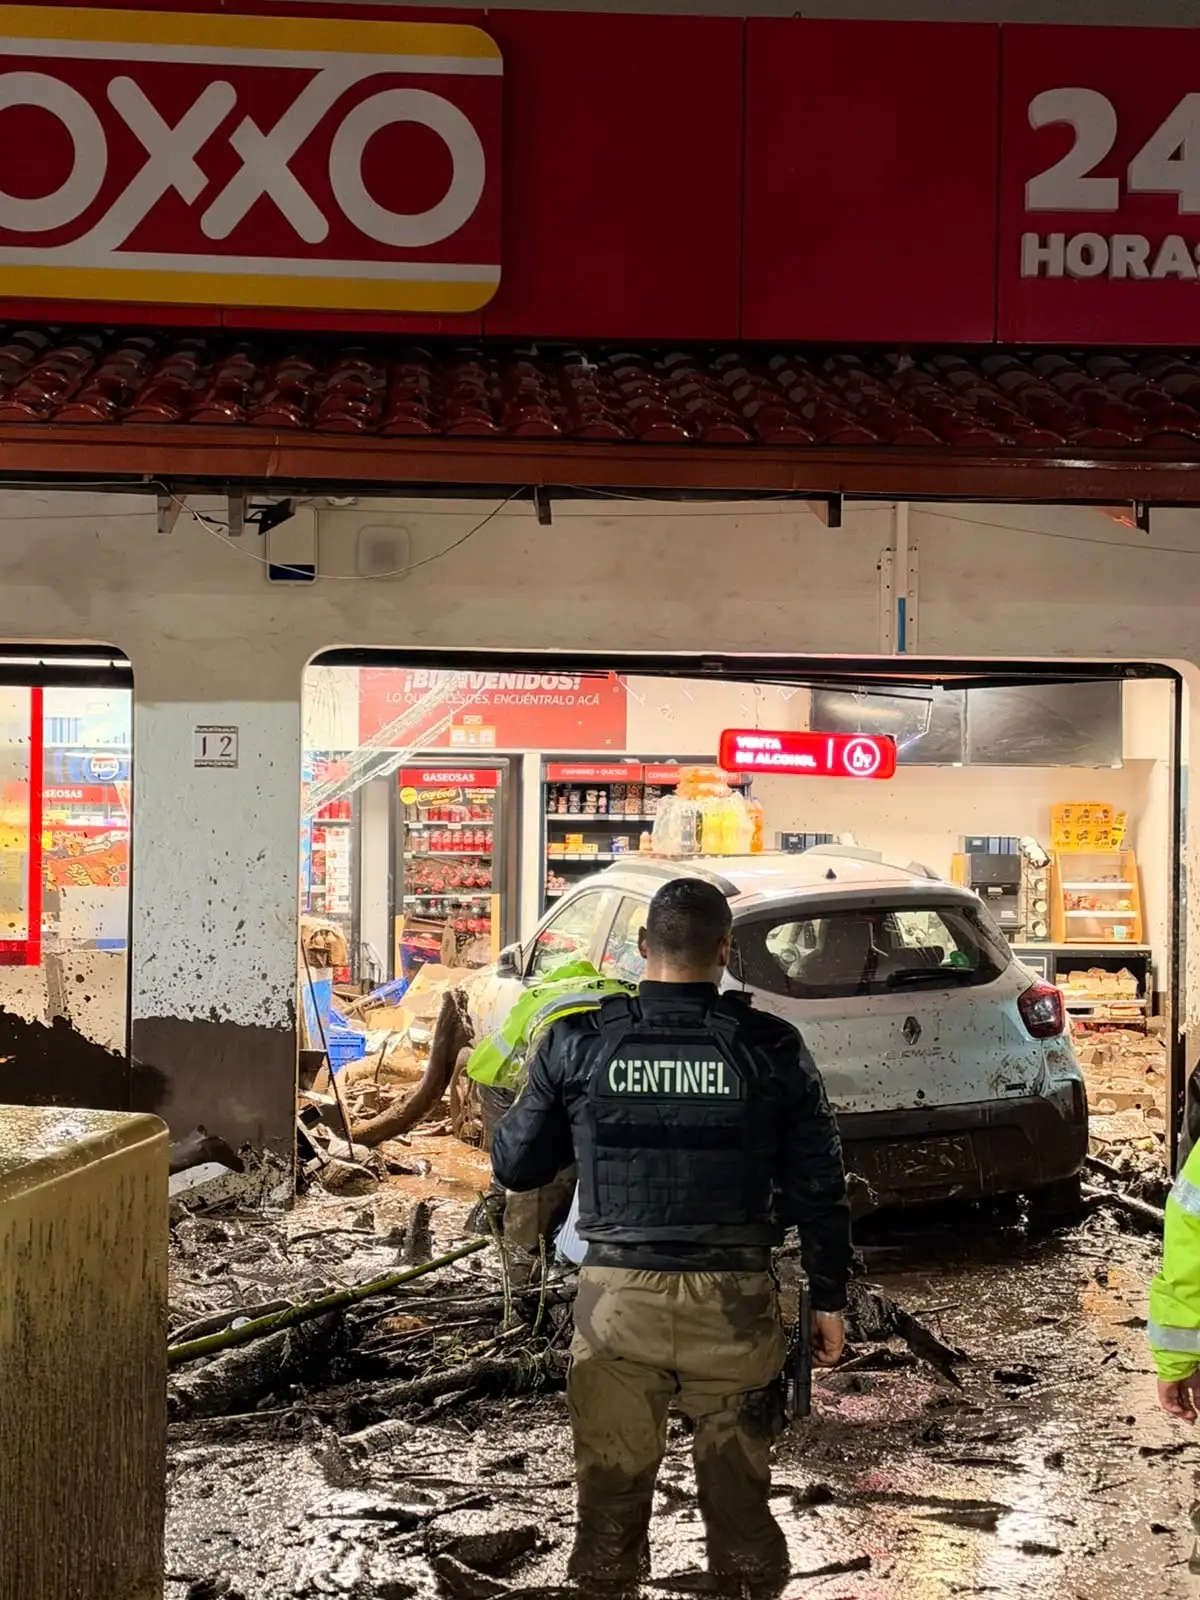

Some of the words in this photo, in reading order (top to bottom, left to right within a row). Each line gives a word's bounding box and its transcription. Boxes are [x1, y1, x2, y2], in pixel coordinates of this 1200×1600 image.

[0, 70, 486, 247] OXXO
[1025, 86, 1200, 215] 24
[1020, 231, 1200, 280] HORA
[404, 671, 582, 692] ¡BIVENIDOS!
[386, 693, 401, 703] LO
[404, 693, 430, 704] QU
[494, 692, 574, 706] ENCUÉNTRALO
[577, 692, 600, 706] ACÁ
[735, 736, 782, 750] VENTA
[735, 750, 751, 764] DE
[754, 752, 817, 767] ALCOHOL
[422, 772, 476, 782] GASEOSAS
[42, 789, 83, 799] SEOSAS
[608, 1059, 730, 1094] CENTINEL
